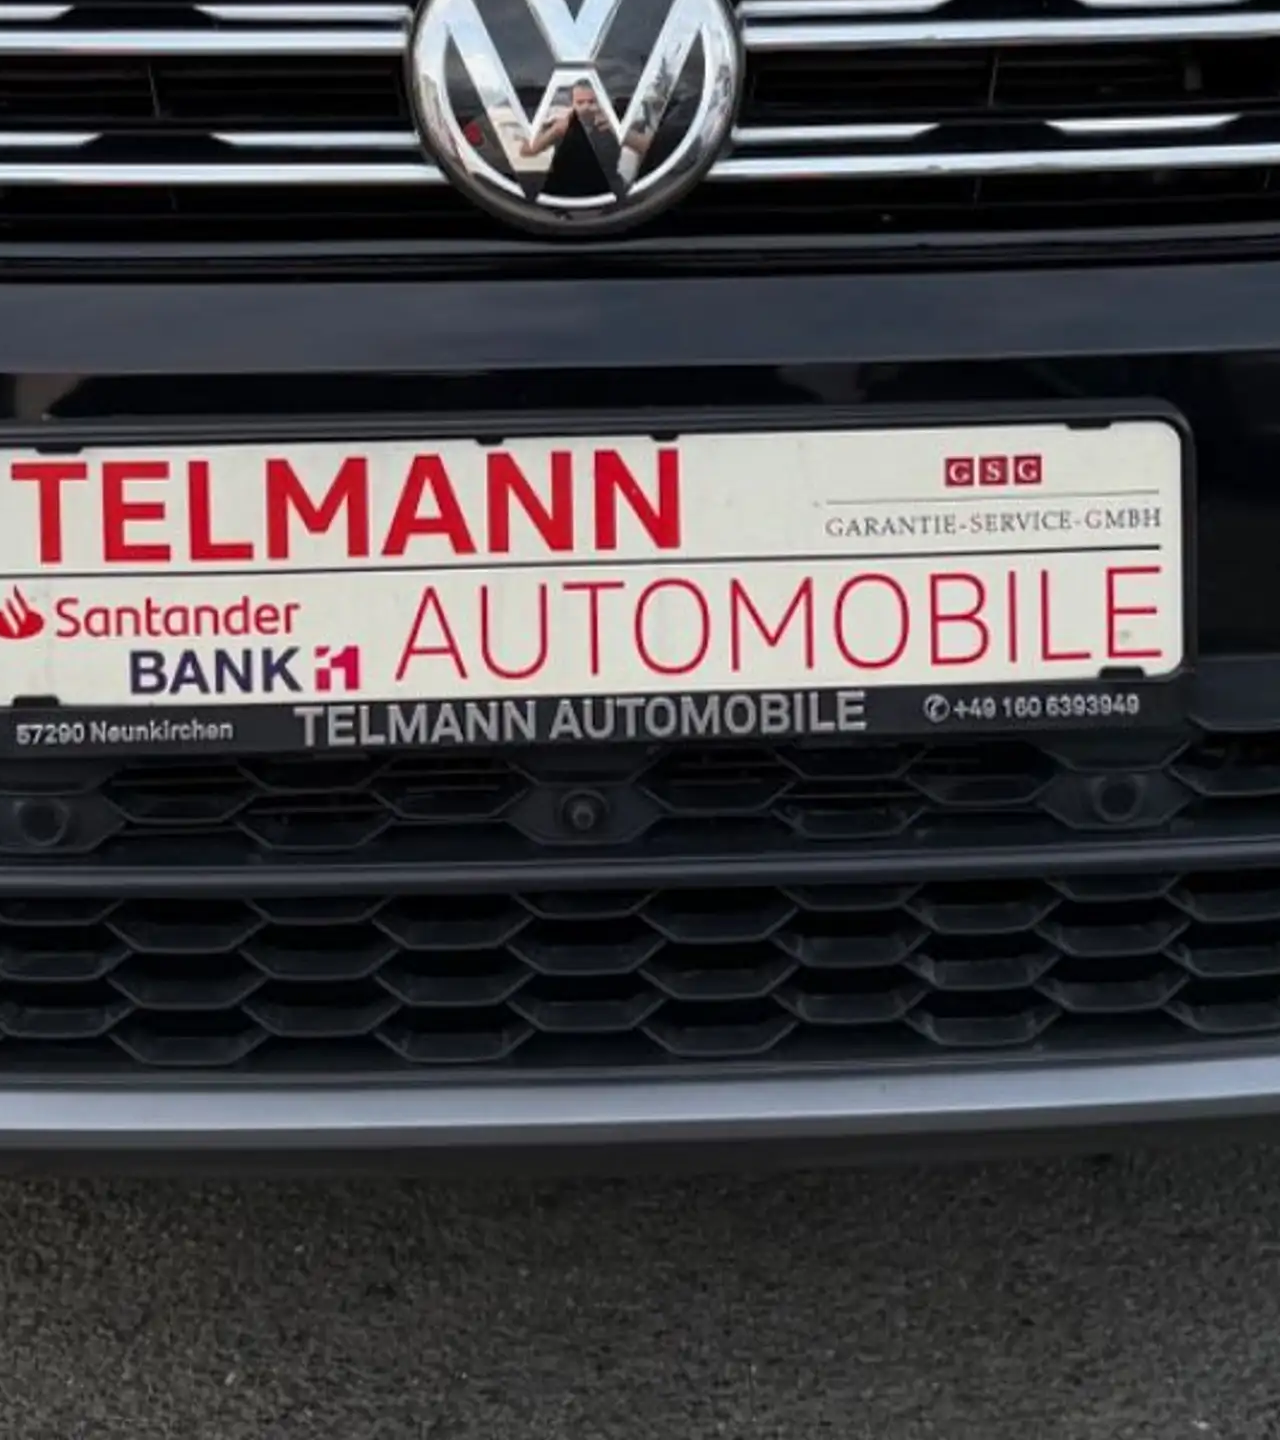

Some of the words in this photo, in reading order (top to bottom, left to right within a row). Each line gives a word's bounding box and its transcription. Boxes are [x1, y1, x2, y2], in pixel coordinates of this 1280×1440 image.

[944, 454, 1043, 487] GSG
[11, 449, 681, 563] TELMANN
[825, 506, 1162, 538] GARANTIE-SERVICE-GMBH
[55, 596, 300, 639] Santander
[395, 565, 1163, 681] AUTOMOBILE
[294, 700, 536, 748] TELMANN
[549, 690, 867, 740] AUTOMOBILE
[953, 699, 997, 720] +49
[16, 722, 85, 746] 57290
[90, 719, 234, 744] Neunkirchen
